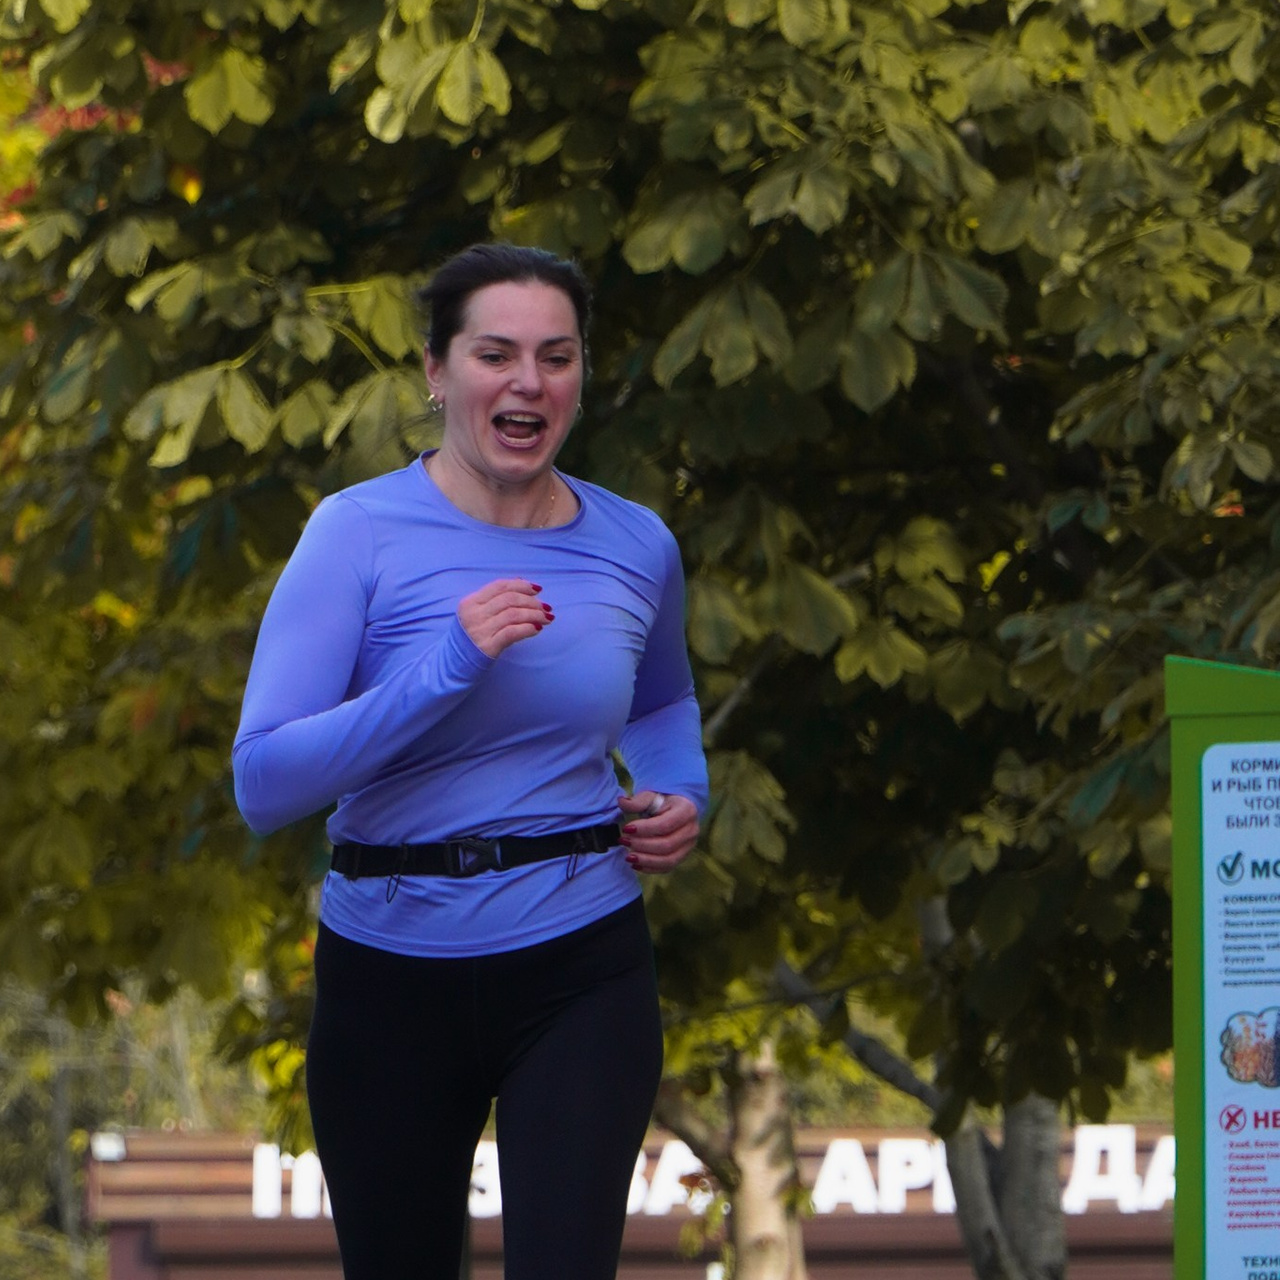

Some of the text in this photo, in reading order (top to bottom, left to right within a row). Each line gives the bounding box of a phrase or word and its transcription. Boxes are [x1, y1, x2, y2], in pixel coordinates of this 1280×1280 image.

[1211, 778, 1223, 793] И
[1227, 777, 1262, 792] РЫБ
[1226, 814, 1270, 830] БЫЛИ
